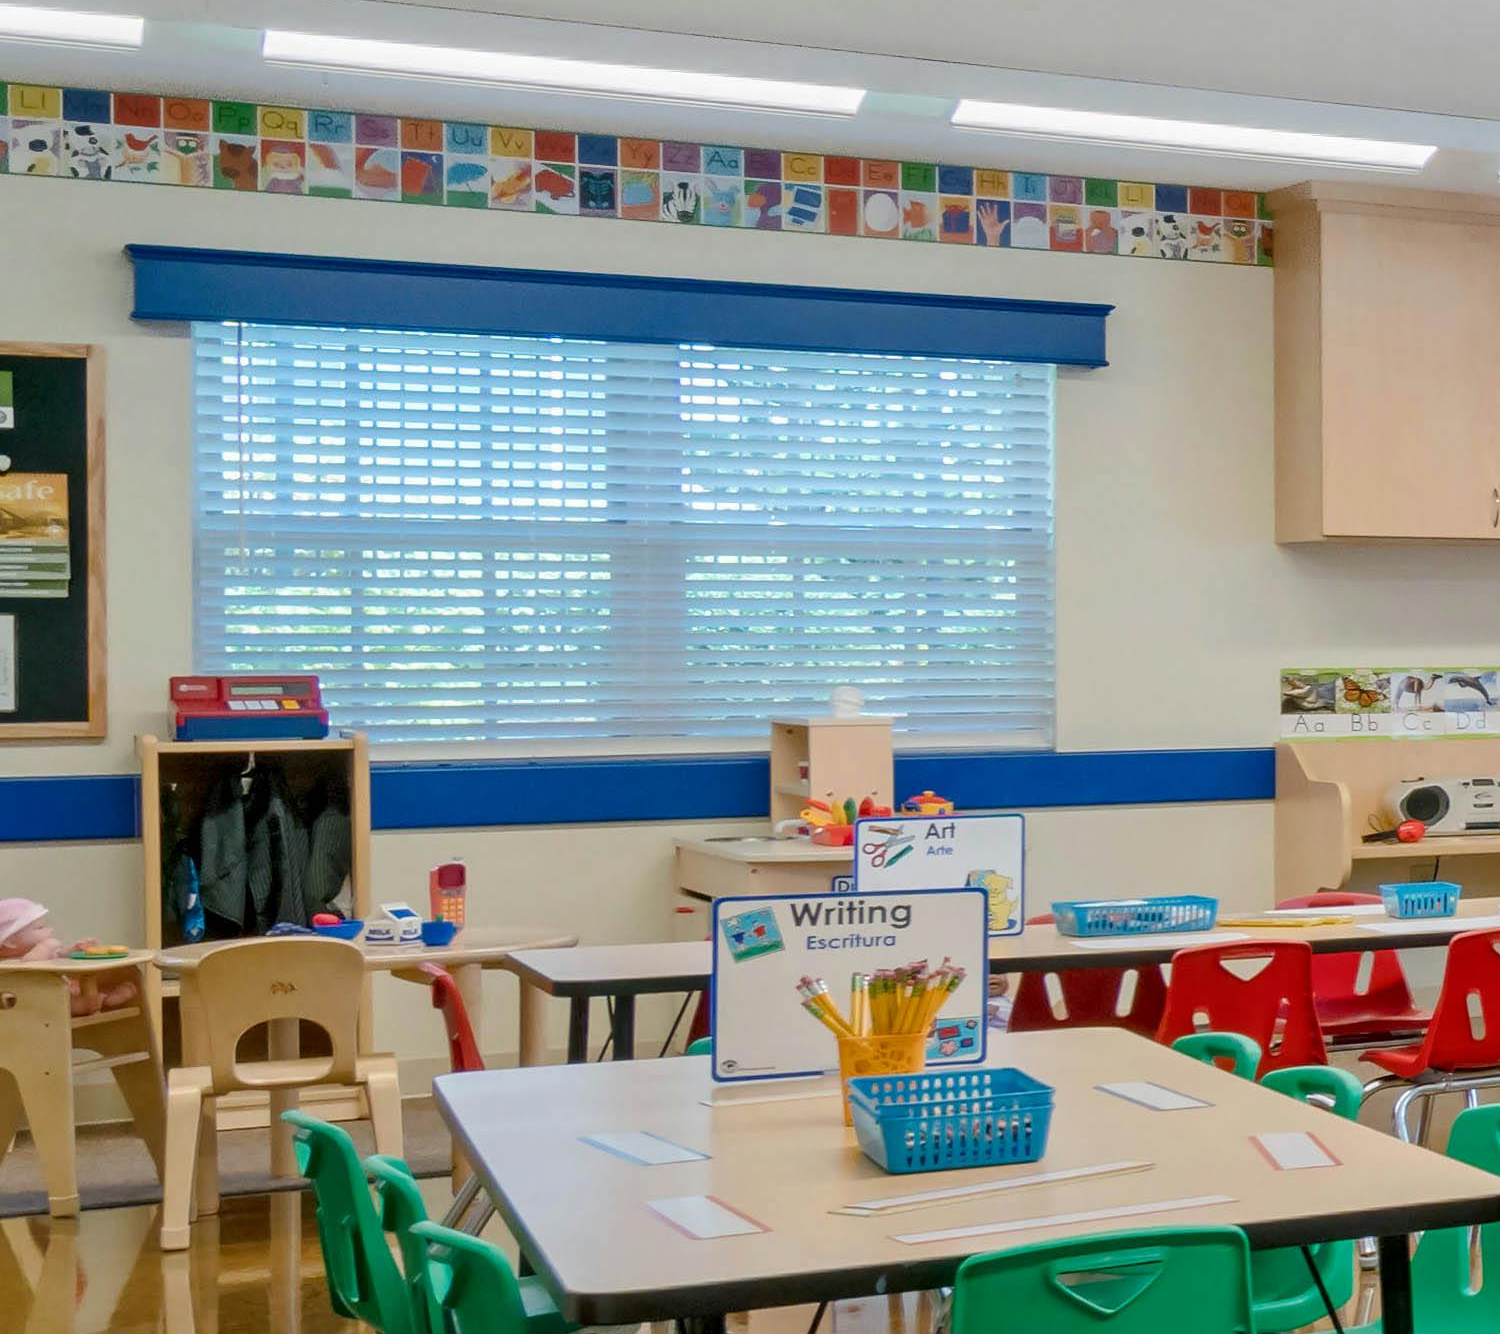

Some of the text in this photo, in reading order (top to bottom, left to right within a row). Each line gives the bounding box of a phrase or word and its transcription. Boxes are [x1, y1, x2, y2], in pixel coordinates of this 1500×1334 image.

[925, 822, 956, 840] Art
[926, 845, 953, 856] Arte
[791, 901, 912, 928] Writing
[807, 934, 896, 950] Escritura
